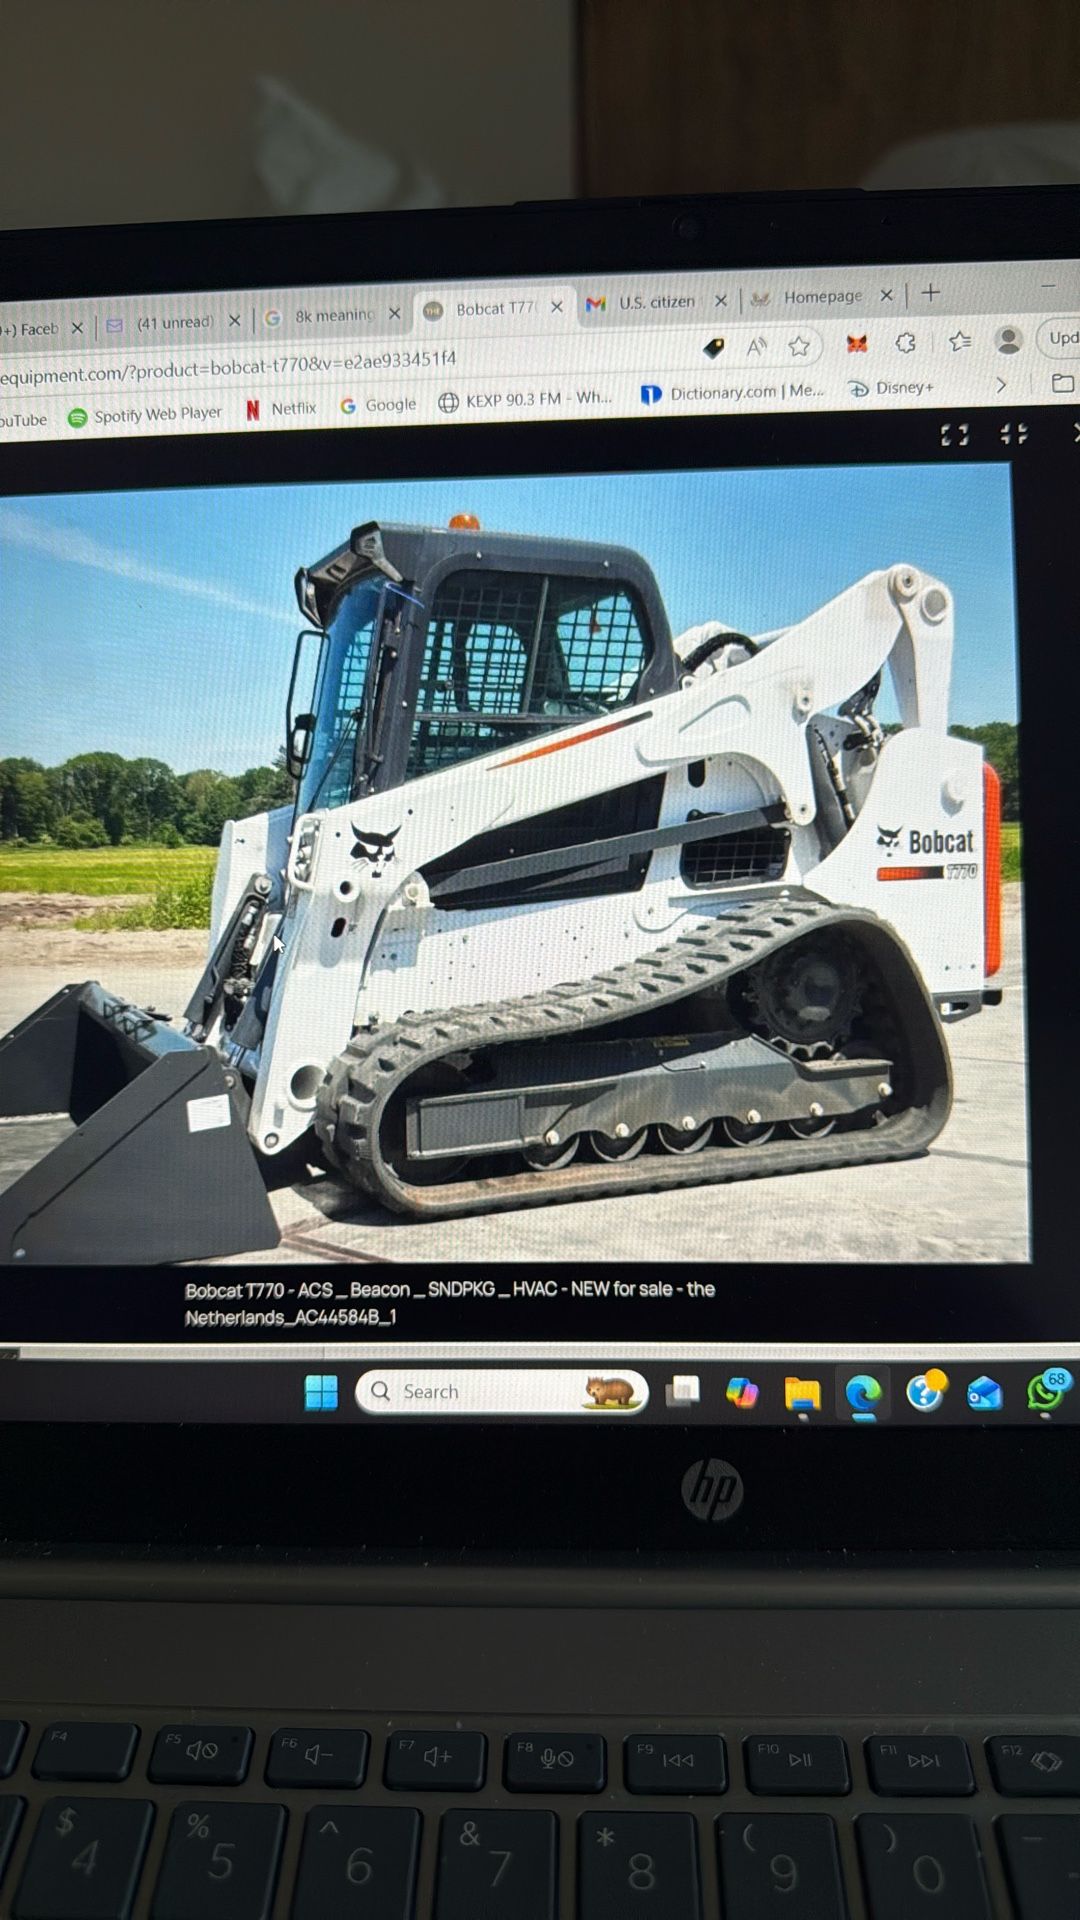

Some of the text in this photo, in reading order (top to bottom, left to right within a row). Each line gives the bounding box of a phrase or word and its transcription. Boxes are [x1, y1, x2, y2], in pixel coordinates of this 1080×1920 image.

[620, 295, 695, 310] U.S. citizen
[785, 291, 863, 306] Homepage
[296, 308, 376, 324] 8k meaning
[457, 303, 504, 316] Bobcat
[22, 322, 59, 336] Faceb
[138, 318, 156, 332] (41
[1050, 330, 1080, 347] Upd
[671, 385, 777, 402] Dictionary.com
[790, 384, 824, 397] Me...
[877, 381, 934, 397] Disney+
[366, 397, 417, 413] Google
[467, 395, 502, 408] KEXP
[506, 393, 535, 406] 90.3
[540, 392, 561, 405] FM
[577, 391, 612, 404] Wh...
[95, 409, 142, 425] Spotify
[146, 408, 177, 421] Web
[182, 406, 222, 422] Player
[272, 402, 317, 415] Netflix
[910, 829, 974, 855] Bobcat
[947, 863, 978, 880] T770
[185, 1283, 244, 1299] Bobcat
[246, 1283, 284, 1299] T770
[297, 1282, 333, 1299] ACS
[350, 1282, 411, 1299] Beacon
[428, 1281, 495, 1298] SNDPKG
[513, 1281, 558, 1297] HVAC
[571, 1281, 609, 1297] NEW
[614, 1280, 636, 1297] for
[639, 1280, 673, 1297] sale
[687, 1280, 716, 1297] the
[184, 1309, 396, 1326] Netherlands_AC44584B_1
[1048, 1373, 1065, 1385] 68
[404, 1383, 459, 1400] Search
[690, 1459, 737, 1520] hp
[51, 1730, 68, 1742] F4
[165, 1733, 182, 1744] F5
[281, 1737, 298, 1748] F6
[400, 1740, 415, 1750] F7
[517, 1742, 533, 1753] F8
[637, 1743, 653, 1754] F9
[758, 1743, 780, 1754] F10
[1001, 1744, 1024, 1755] F12
[71, 1840, 99, 1876] 4
[208, 1843, 236, 1880] 5
[346, 1847, 373, 1884] 6
[489, 1851, 512, 1887] 7
[628, 1853, 655, 1890] 8
[770, 1854, 797, 1892] 9
